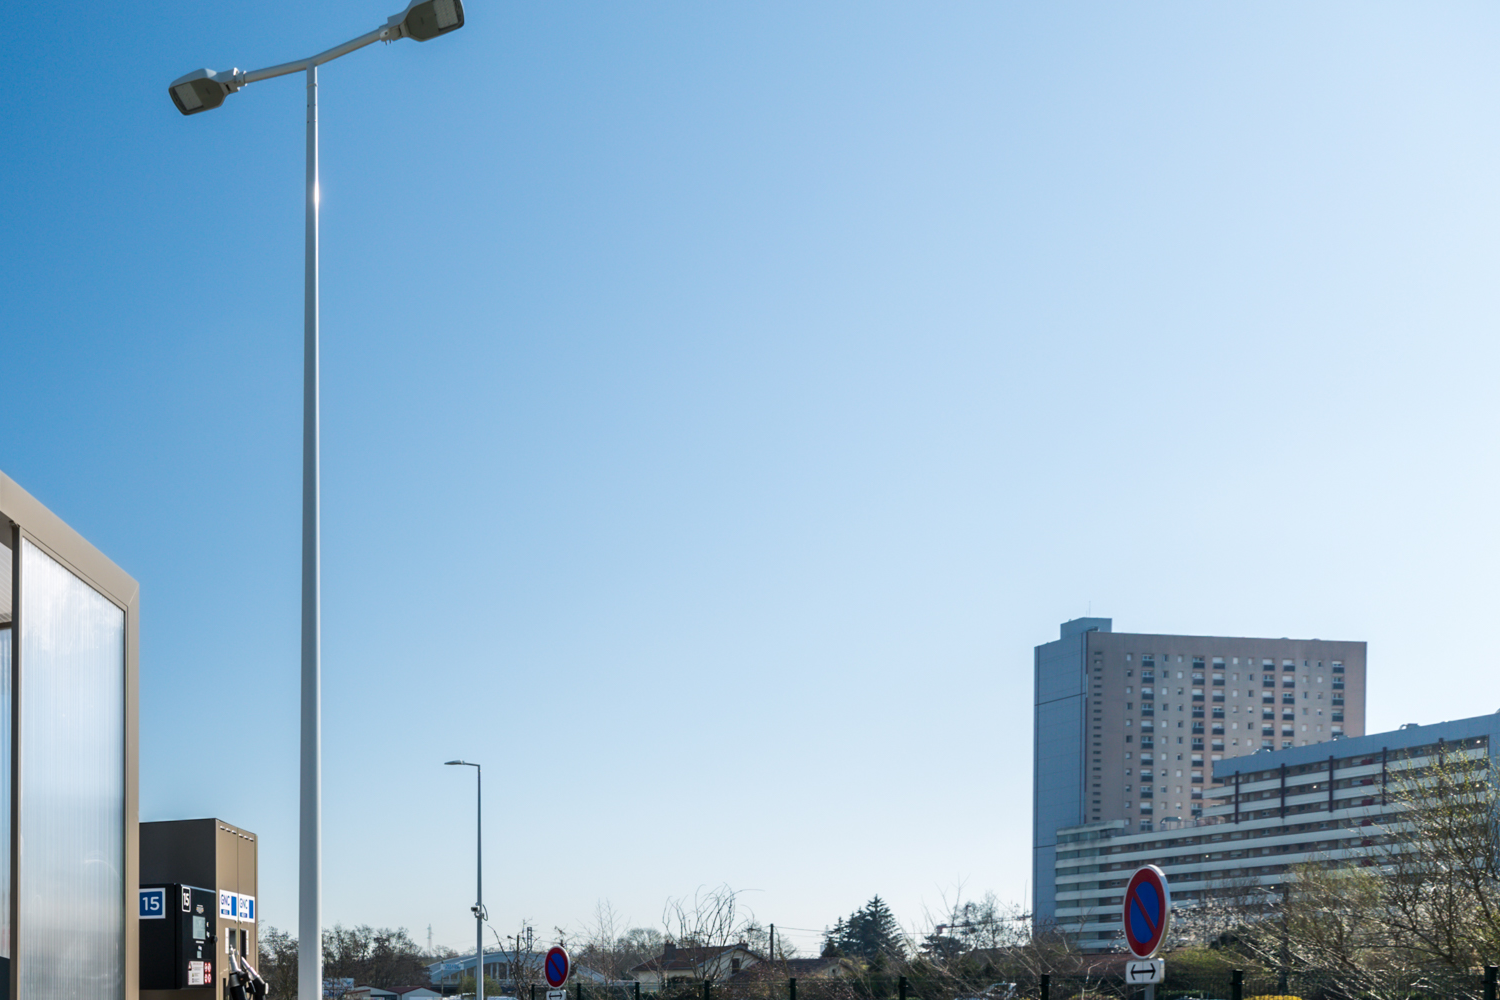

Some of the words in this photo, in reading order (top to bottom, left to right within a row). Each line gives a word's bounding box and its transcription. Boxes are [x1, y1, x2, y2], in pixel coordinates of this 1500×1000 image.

[142, 896, 160, 911] 15
[183, 892, 190, 907] 15
[220, 893, 231, 906] GNC
